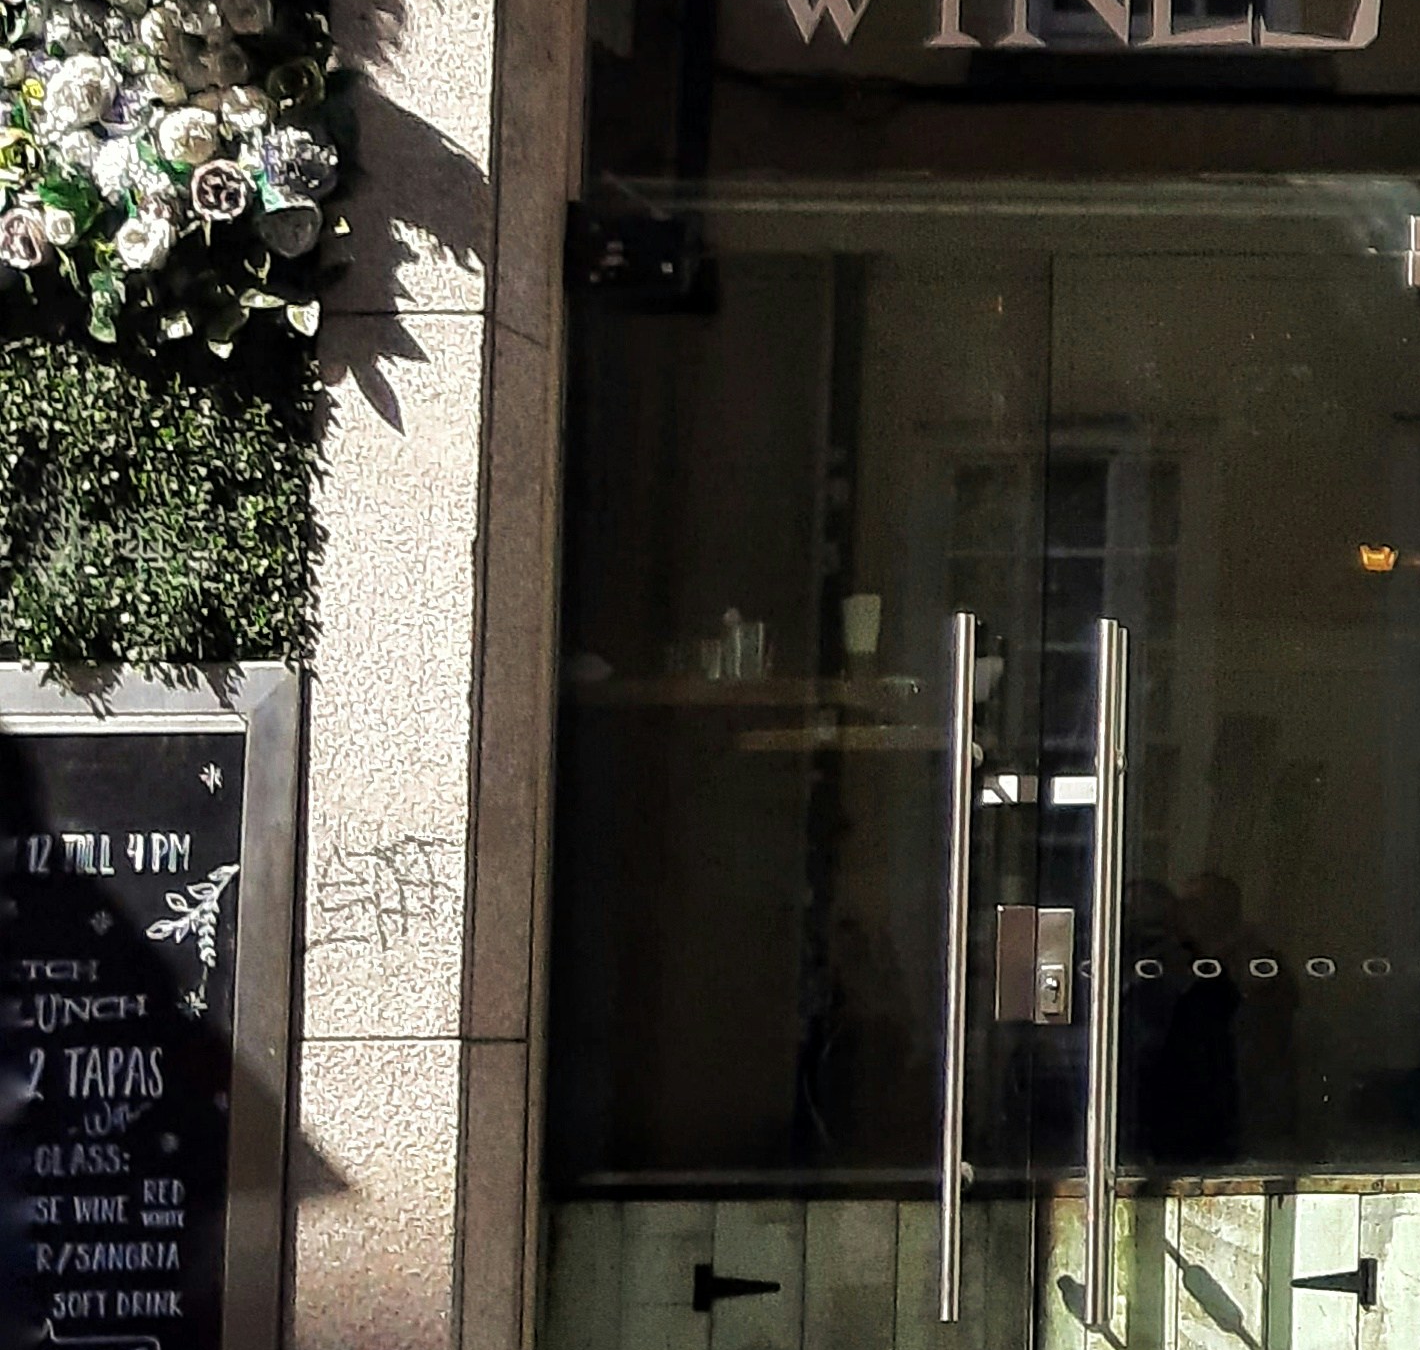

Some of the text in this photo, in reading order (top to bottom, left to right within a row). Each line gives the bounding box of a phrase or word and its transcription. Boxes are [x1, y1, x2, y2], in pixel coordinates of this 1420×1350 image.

[62, 833, 115, 876] TILL
[64, 1046, 164, 1098] TAPAS
[143, 1179, 186, 1206] RED
[73, 1196, 129, 1225] WINE
[35, 1242, 181, 1276] R/SANGRIA
[53, 1292, 184, 1319] SOFT DRINK
